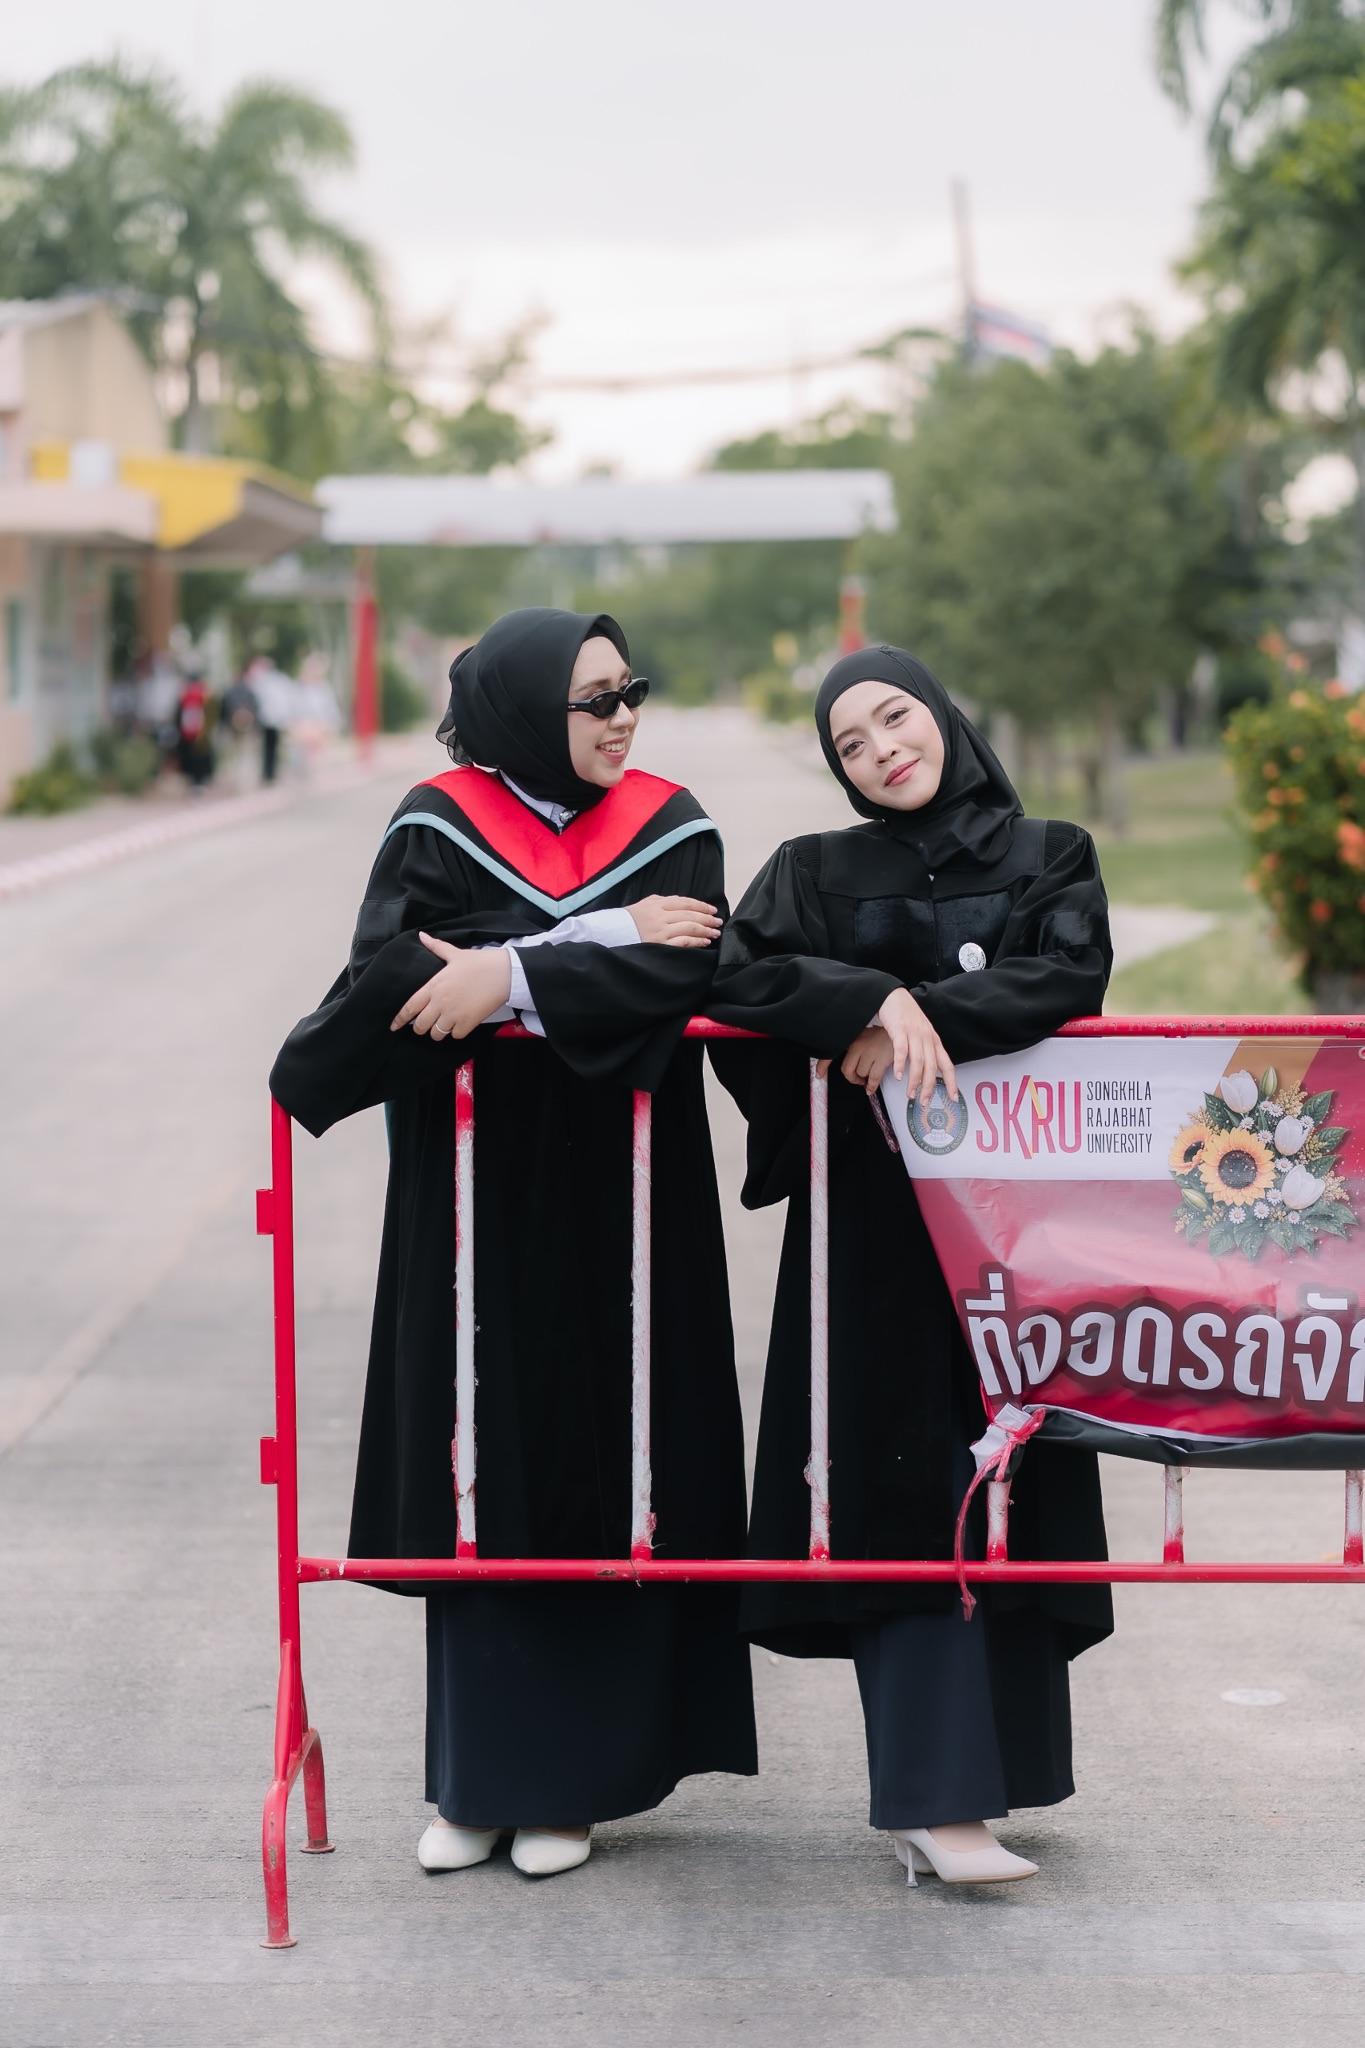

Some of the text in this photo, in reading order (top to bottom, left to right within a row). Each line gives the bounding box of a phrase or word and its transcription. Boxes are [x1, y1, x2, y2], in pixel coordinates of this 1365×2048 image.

[1086, 1080, 1152, 1101] SONGKHLA
[975, 1075, 1082, 1160] SKRU
[1086, 1107, 1152, 1128] RAJABHAT
[1086, 1133, 1153, 1154] UNIVERSITY
